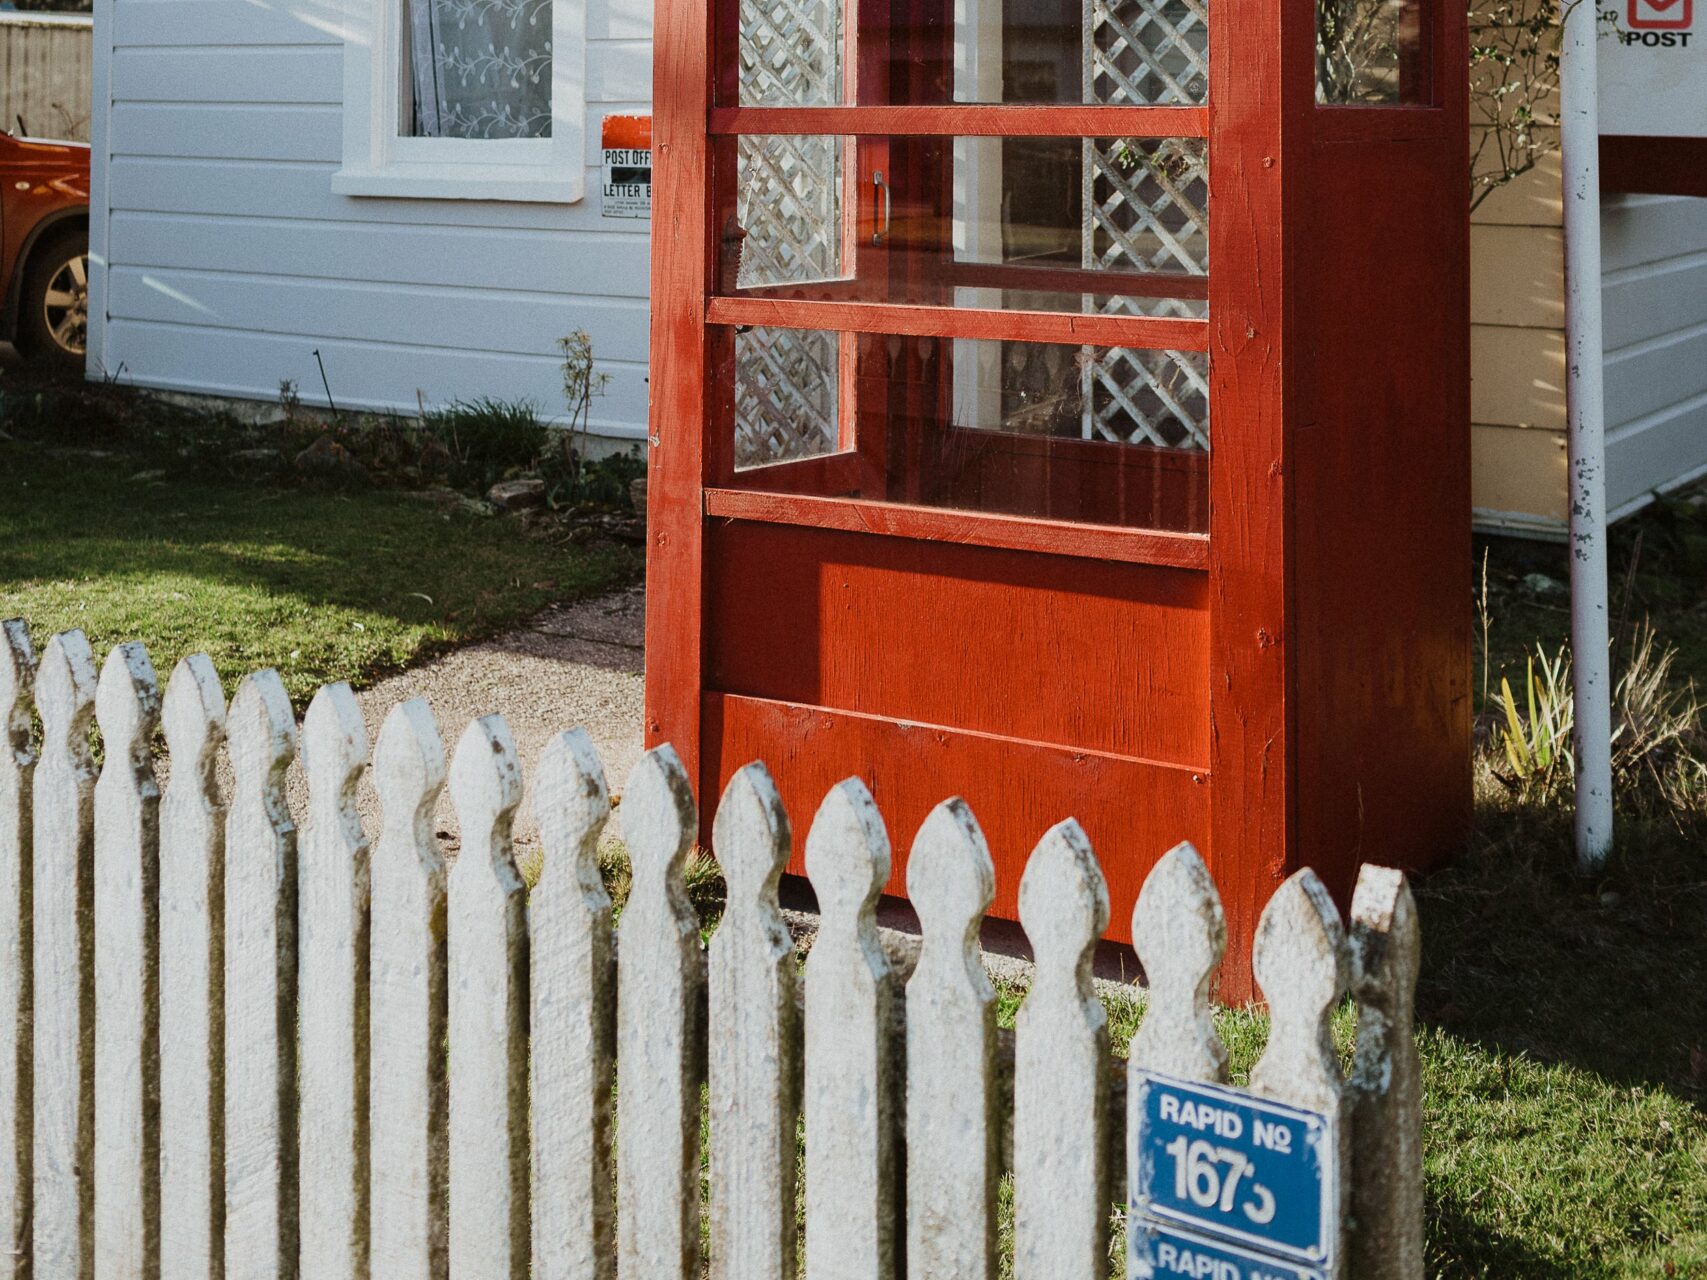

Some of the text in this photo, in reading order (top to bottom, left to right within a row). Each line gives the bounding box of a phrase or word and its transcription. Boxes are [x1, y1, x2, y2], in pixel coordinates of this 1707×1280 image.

[1626, 31, 1692, 47] POST
[605, 150, 652, 166] POST OFF
[603, 184, 640, 198] LETTER
[1159, 1093, 1243, 1140] RAPID
[1157, 1242, 1241, 1280] RAPID
